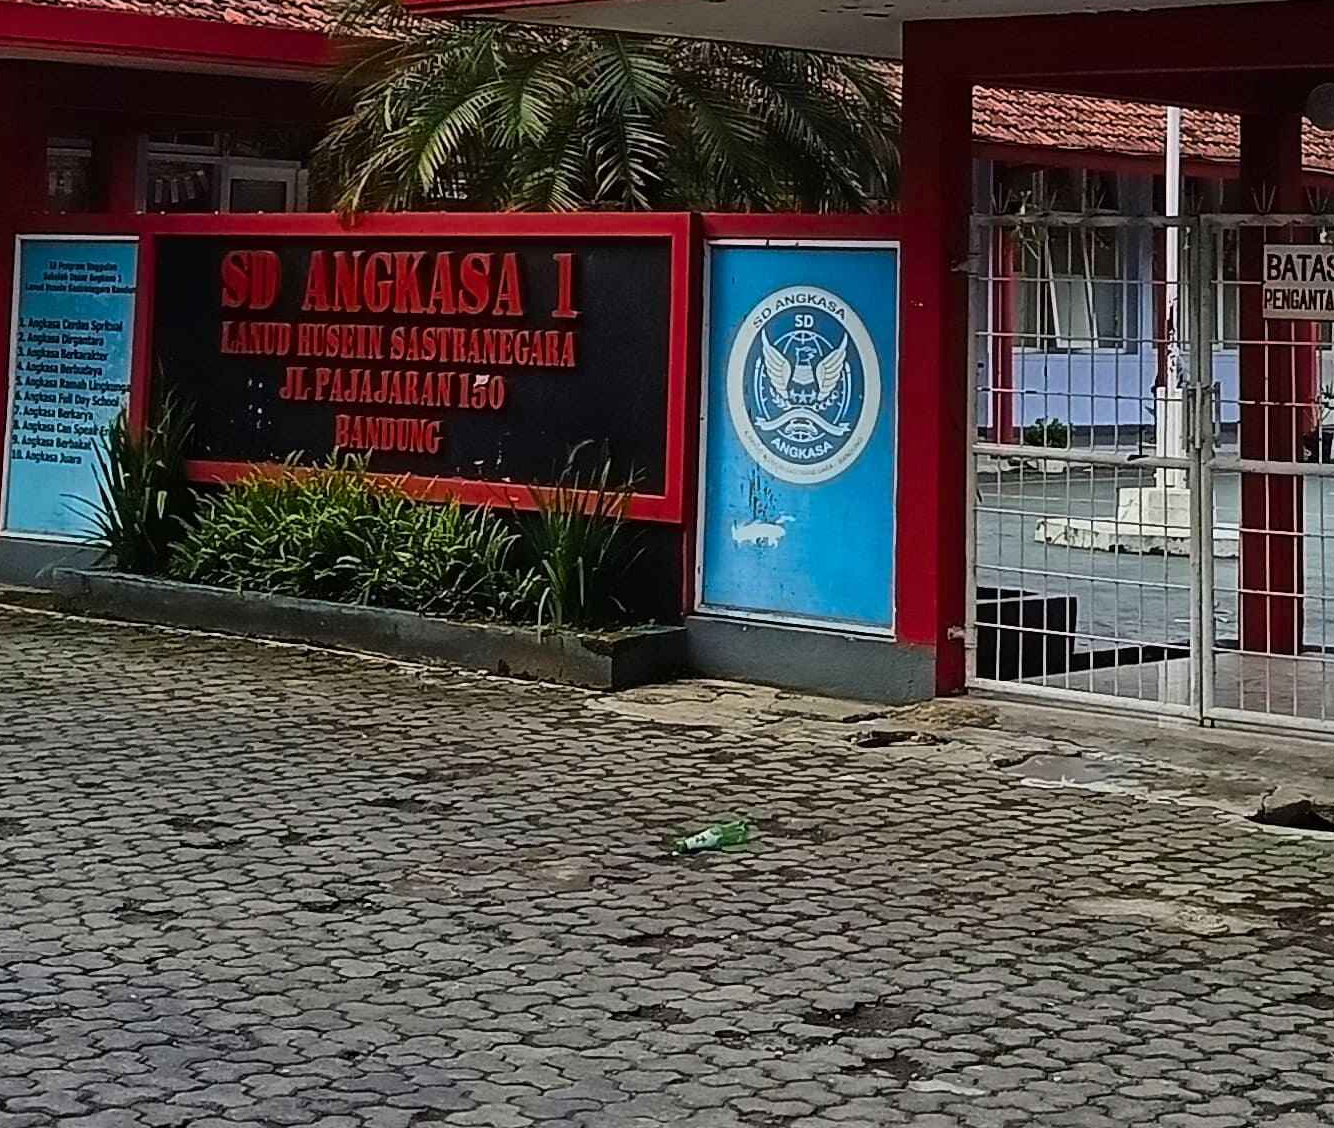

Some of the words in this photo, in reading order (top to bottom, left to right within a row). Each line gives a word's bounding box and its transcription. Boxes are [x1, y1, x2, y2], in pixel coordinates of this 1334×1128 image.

[221, 250, 282, 309] SD
[301, 250, 524, 316] ANGKASA
[552, 253, 582, 318] 1
[753, 307, 772, 329] SD
[775, 293, 845, 320] ANGKASA
[28, 318, 60, 330] Angkasa
[795, 314, 814, 328] SD
[27, 333, 60, 345] Angkasa
[62, 334, 104, 347] Dirgantara
[221, 321, 291, 356] LANUD
[297, 323, 384, 359] HUSEIN
[390, 326, 575, 367] SASTRANEGARA
[27, 347, 60, 360] Angkasa
[61, 348, 108, 361] Berkarakter
[27, 362, 58, 374] Angkasa
[26, 376, 58, 389] Angkasa
[279, 367, 311, 400] JL
[315, 367, 455, 406] PAJAJARAN
[458, 372, 505, 409] 150
[24, 391, 57, 404] Angkasa
[58, 392, 73, 404] Full
[75, 394, 91, 408] Day
[91, 395, 119, 407] School
[23, 406, 55, 418] Angkasa
[57, 408, 94, 422] Berkarya
[22, 420, 55, 433] Angkasa
[57, 422, 72, 433] Can
[73, 423, 98, 436] Speak
[335, 414, 443, 453] BANDUNG
[21, 435, 54, 448] Angkasa
[771, 437, 834, 459] ANGKASA
[26, 450, 58, 463] Angkasa
[59, 453, 82, 464] Juara
